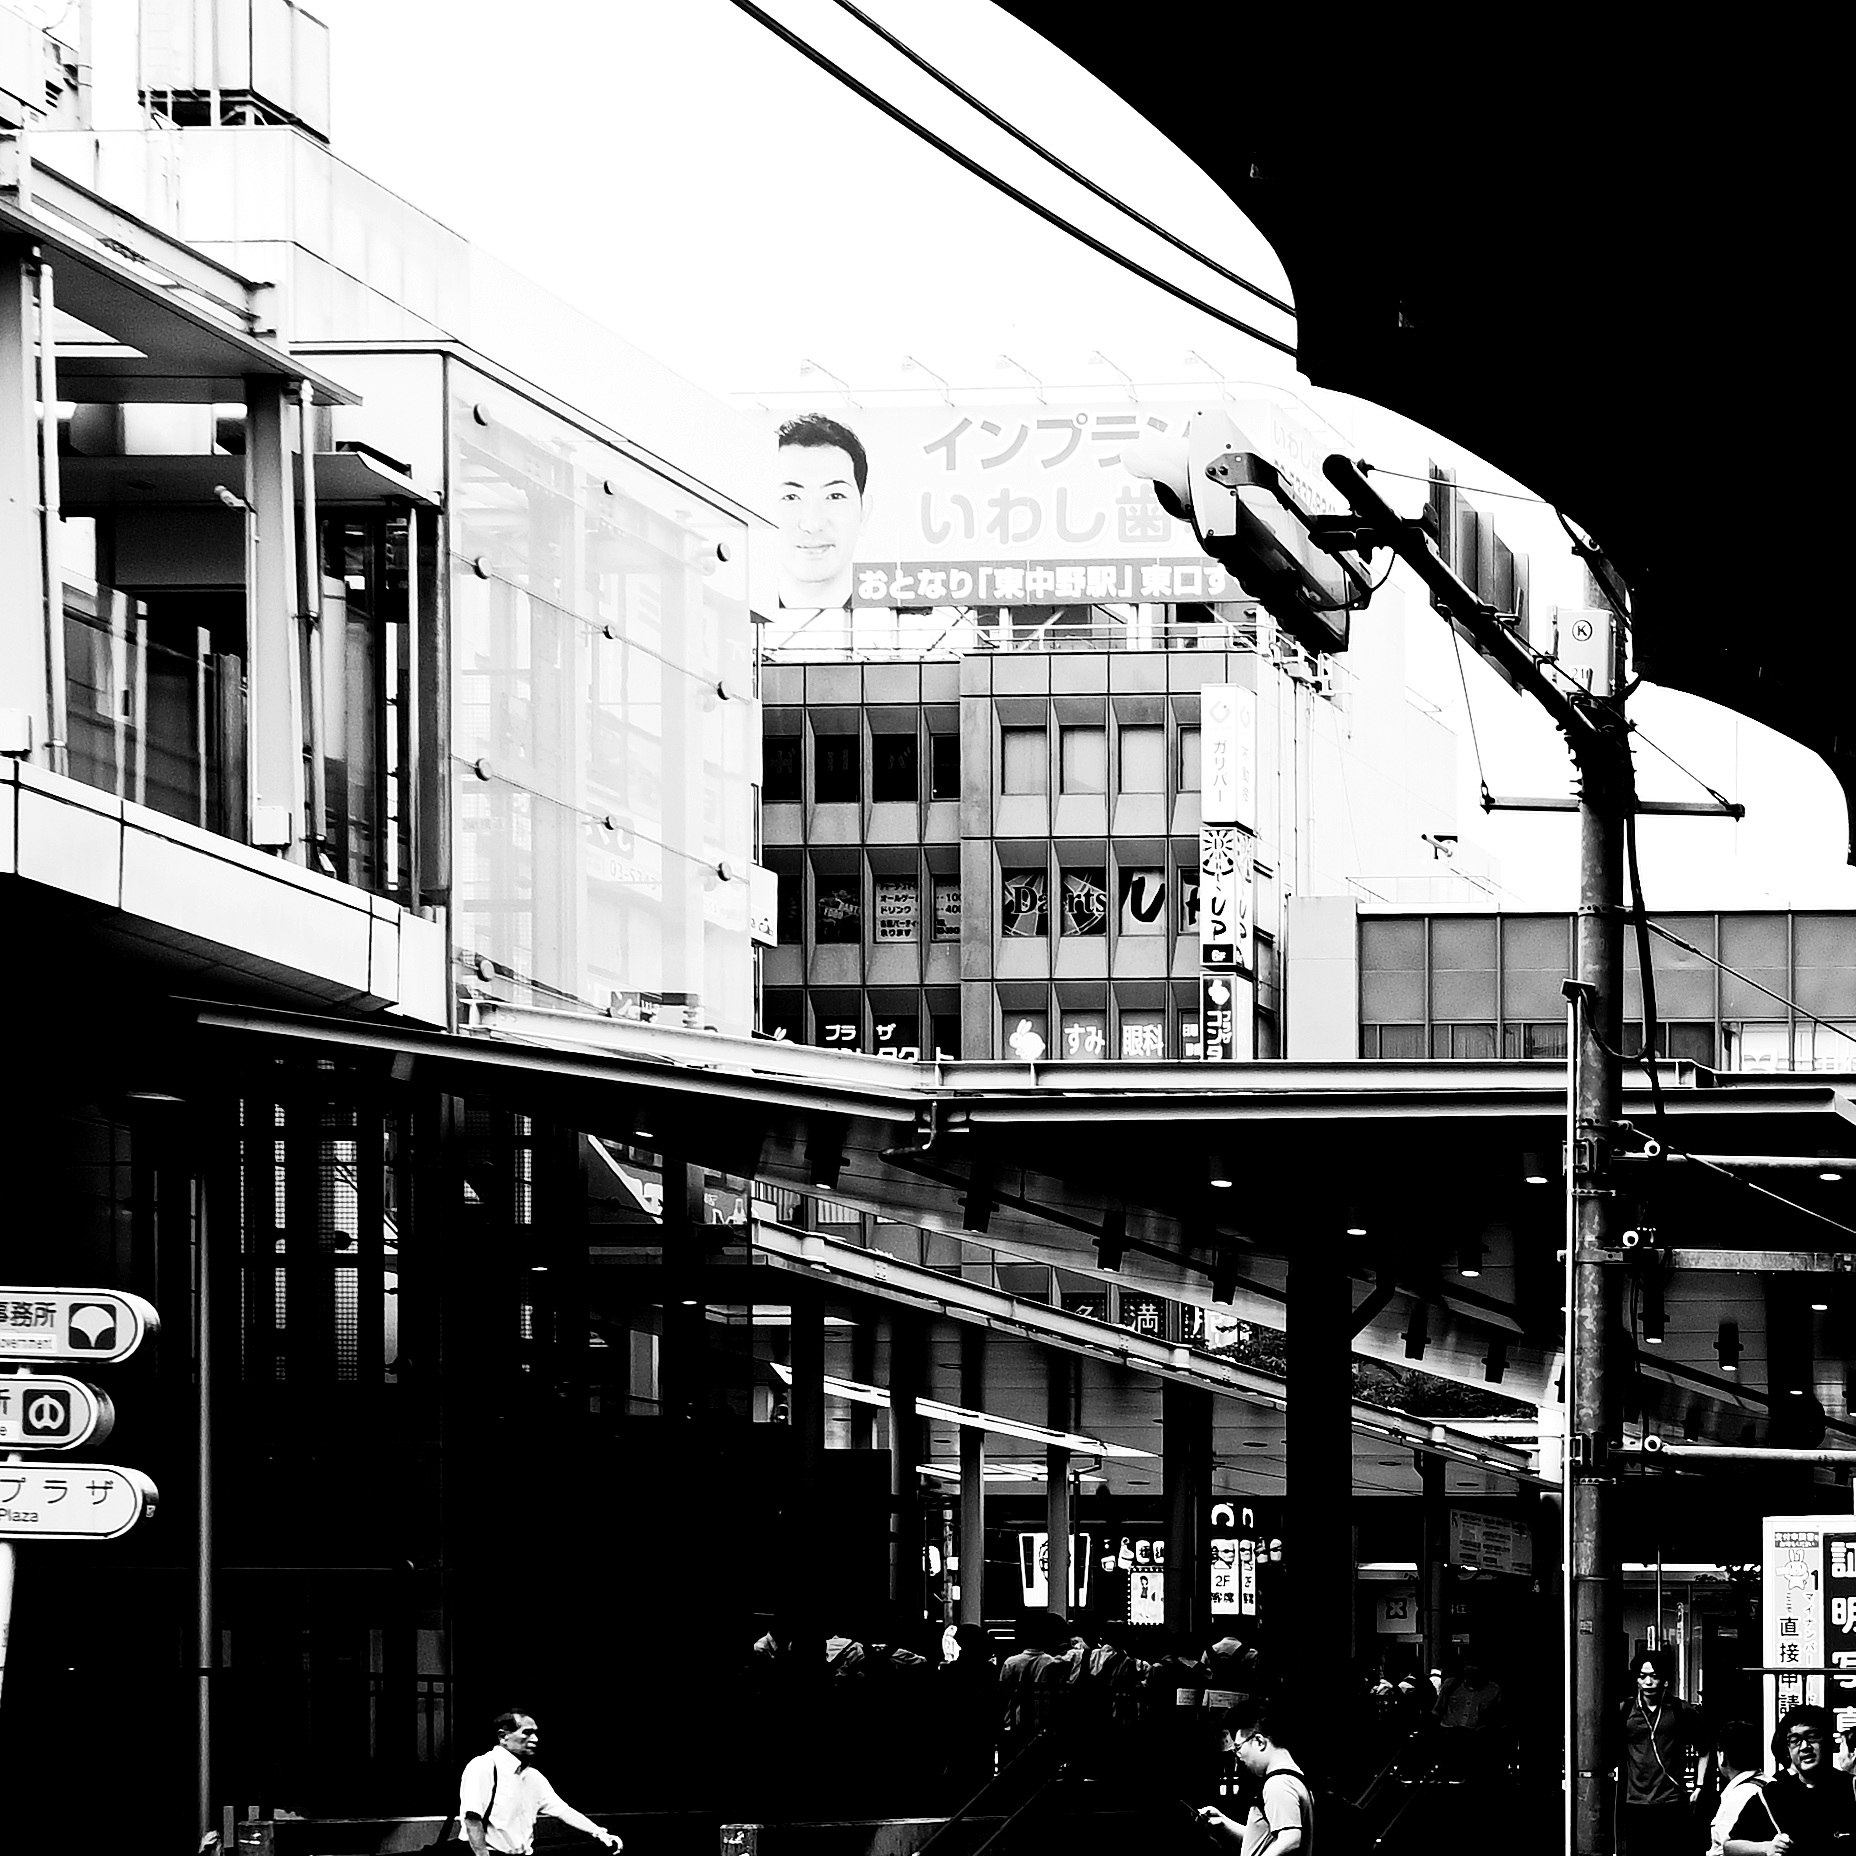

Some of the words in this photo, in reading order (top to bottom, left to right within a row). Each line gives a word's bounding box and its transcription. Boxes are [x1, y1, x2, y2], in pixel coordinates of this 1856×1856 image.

[920, 484, 1191, 545] いわし歯
[1213, 739, 1228, 802] ガリバー
[880, 894, 918, 903] オールゲー
[0, 1477, 114, 1505] プラザ
[1215, 1575, 1231, 1587] 2F
